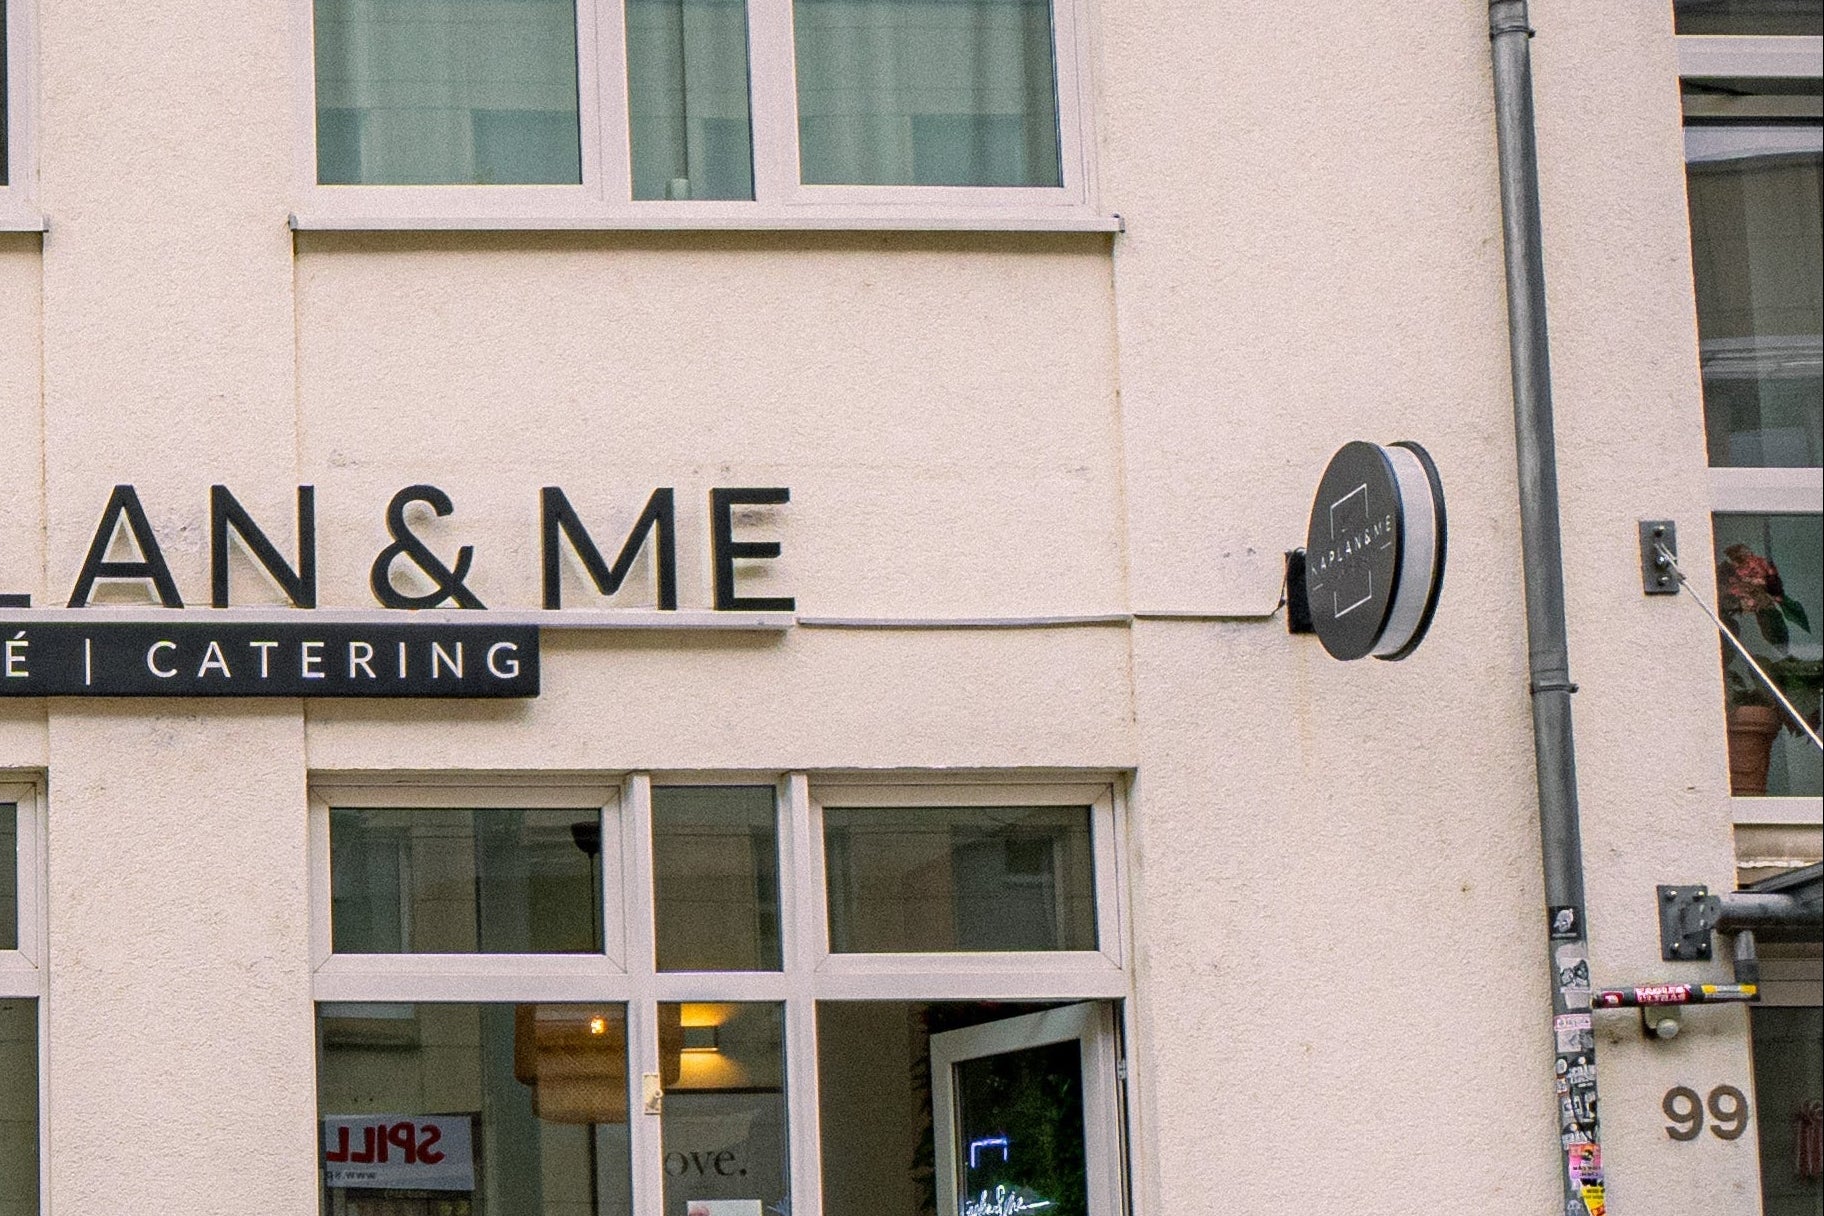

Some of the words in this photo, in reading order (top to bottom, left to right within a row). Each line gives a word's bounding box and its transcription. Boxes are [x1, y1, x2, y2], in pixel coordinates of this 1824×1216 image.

[146, 640, 519, 679] CATERING
[1661, 1084, 1749, 1142] 99
[664, 1150, 748, 1177] ove.
